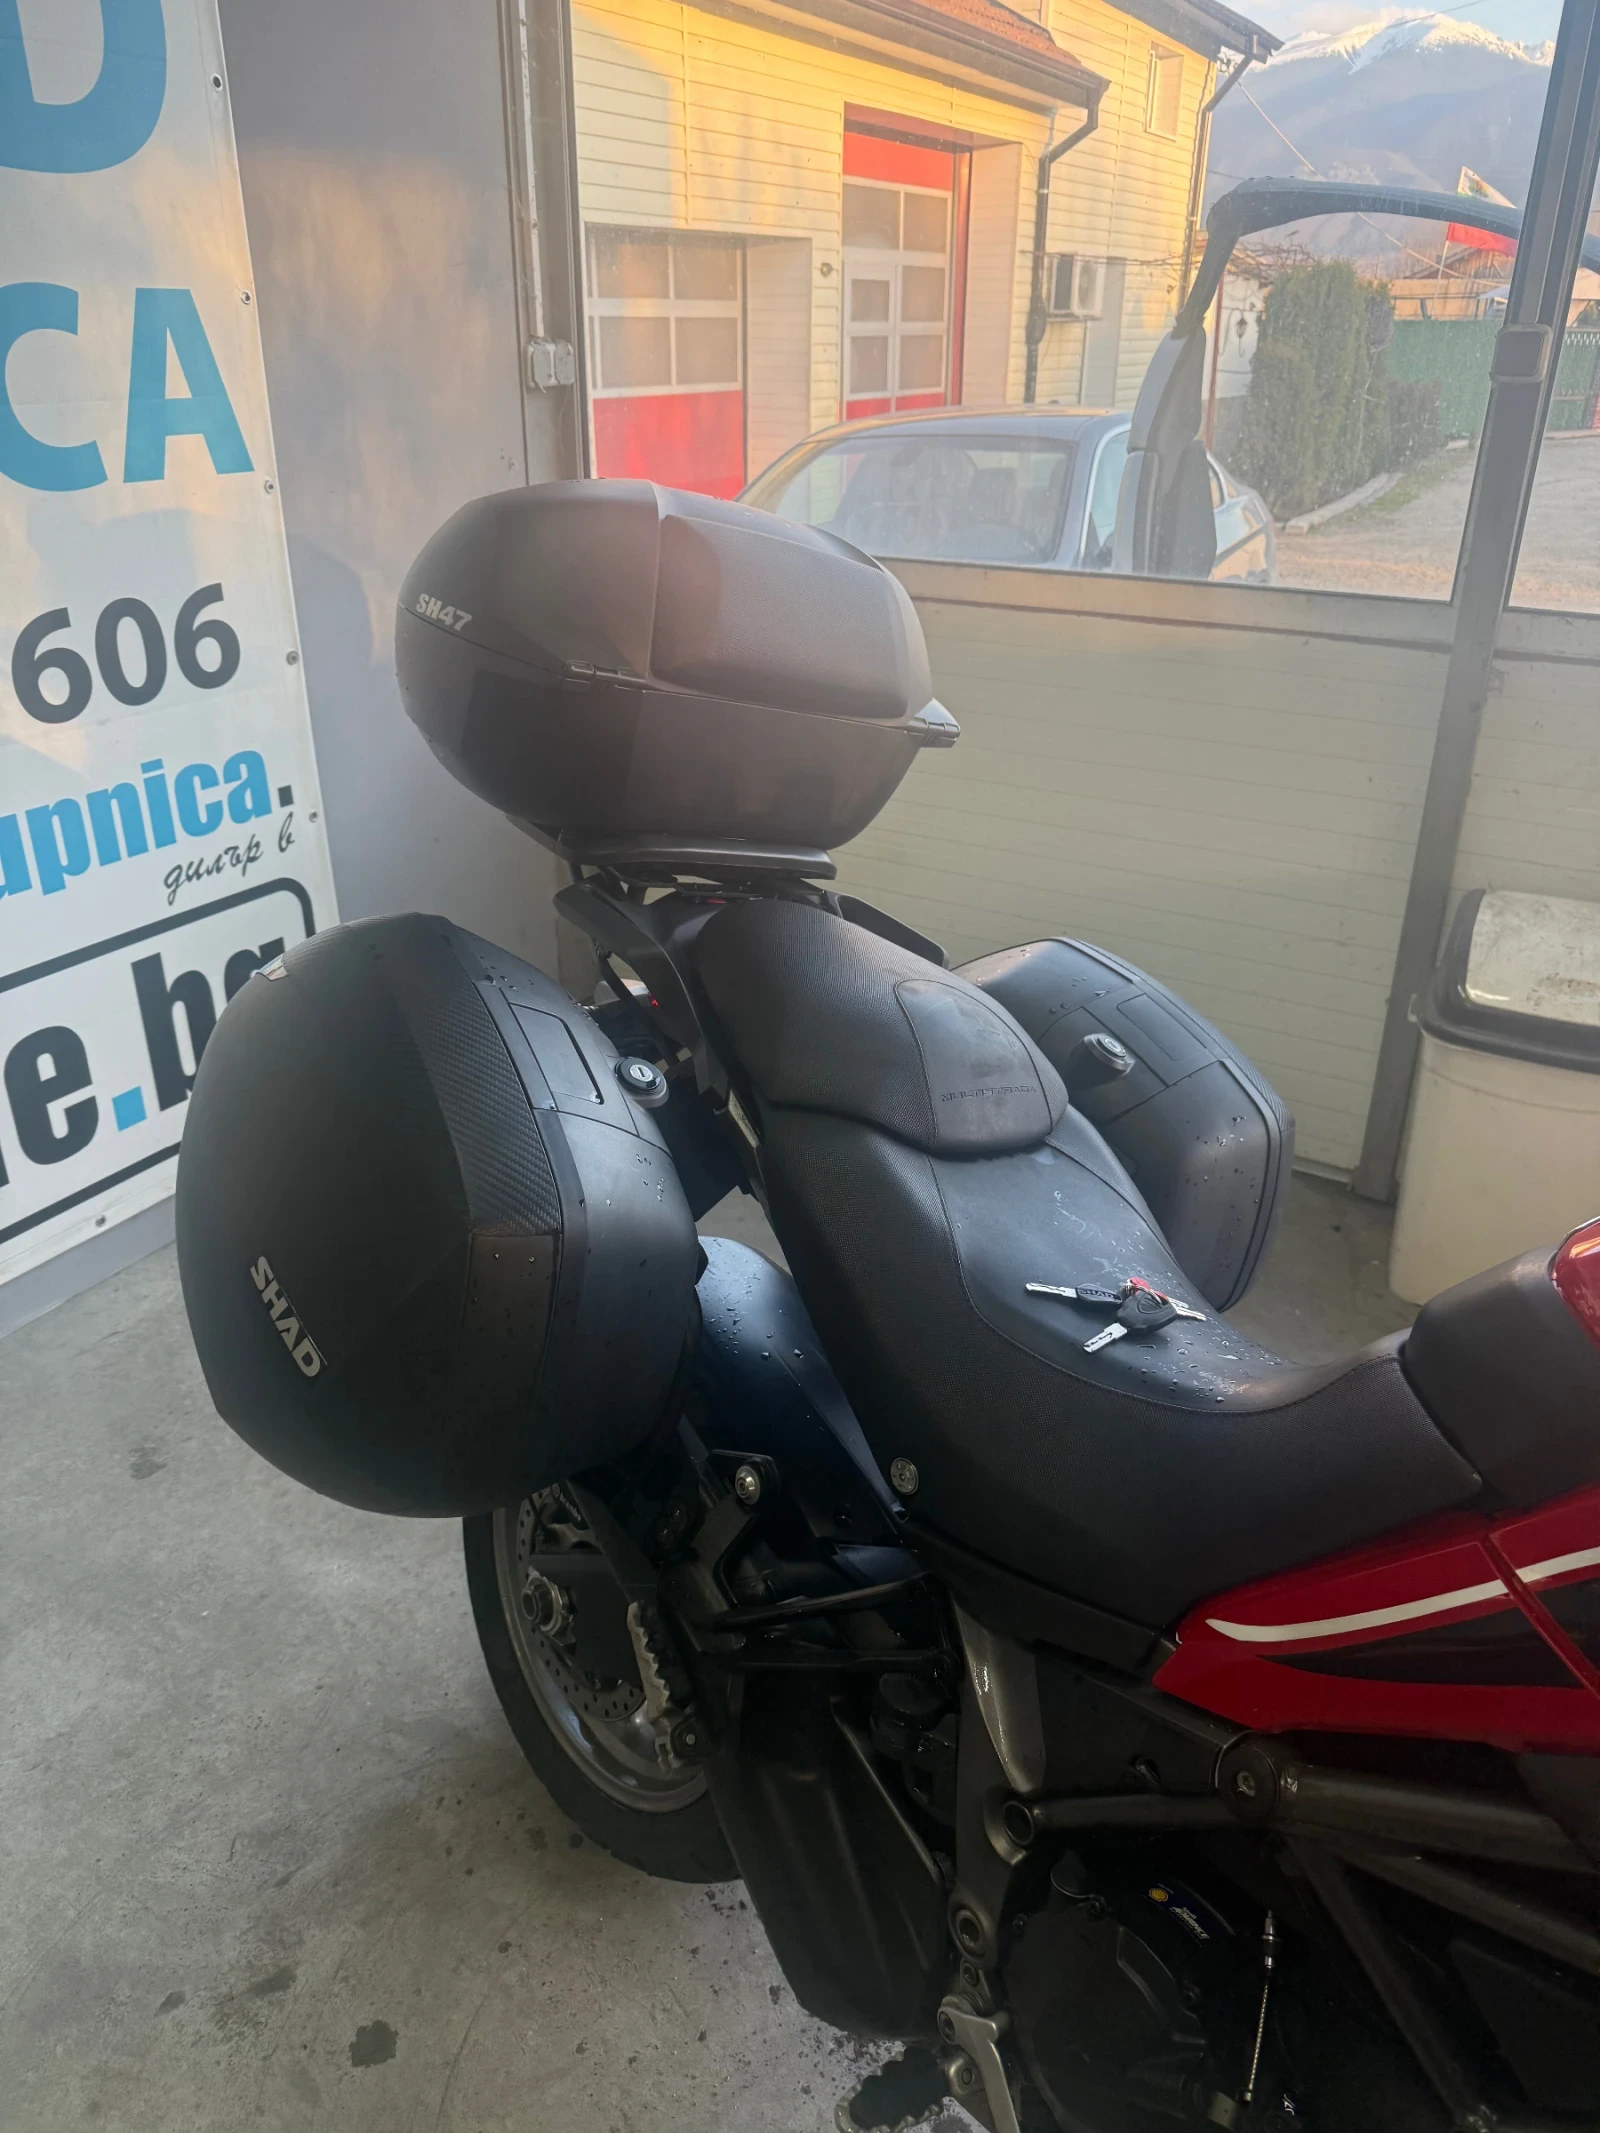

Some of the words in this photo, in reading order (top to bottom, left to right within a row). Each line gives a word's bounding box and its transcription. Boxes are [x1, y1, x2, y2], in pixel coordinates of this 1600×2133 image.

[0, 282, 255, 492] CA
[11, 582, 241, 724] 606
[416, 593, 473, 631] SH47
[940, 1085, 1037, 1101] MULTISTRADA
[249, 1256, 321, 1377] SHAD
